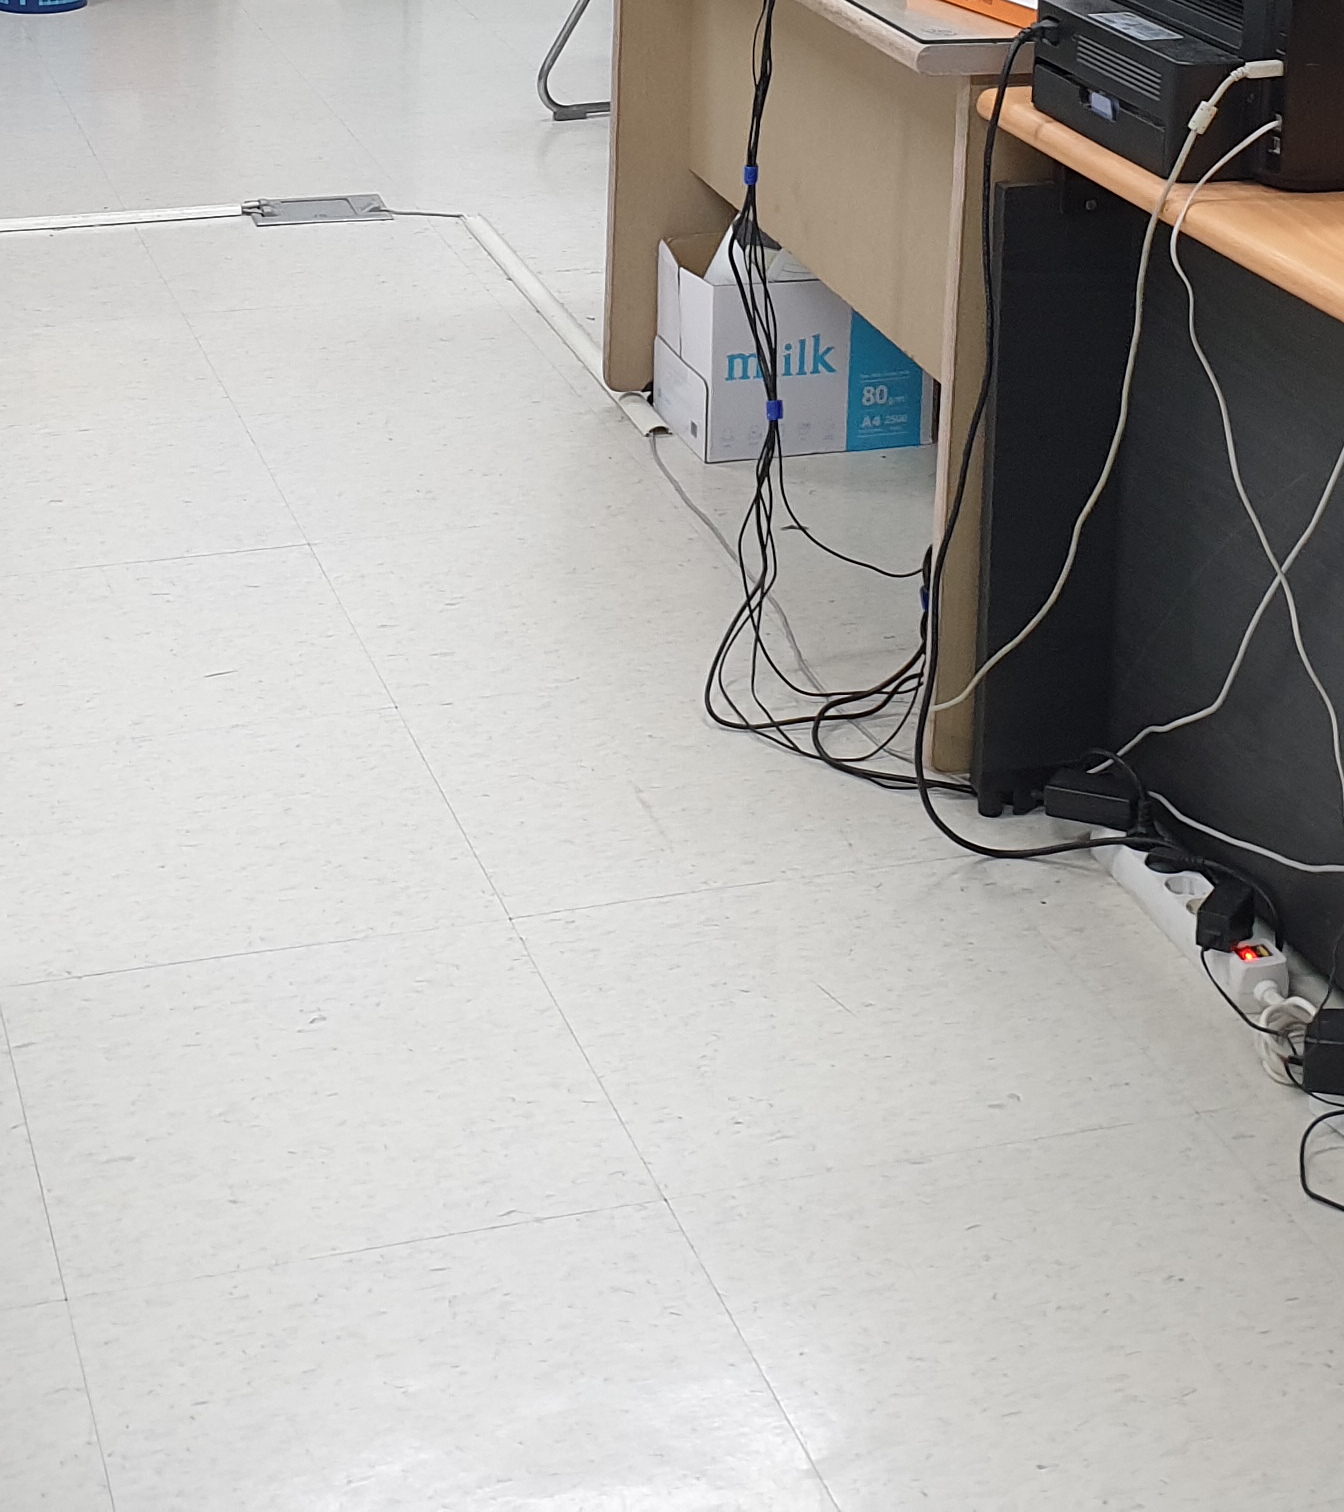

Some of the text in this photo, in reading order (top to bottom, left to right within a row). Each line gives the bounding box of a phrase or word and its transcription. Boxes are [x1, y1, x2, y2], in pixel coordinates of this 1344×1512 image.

[725, 334, 837, 381] milk
[861, 385, 888, 406] 80
[861, 415, 881, 429] A4
